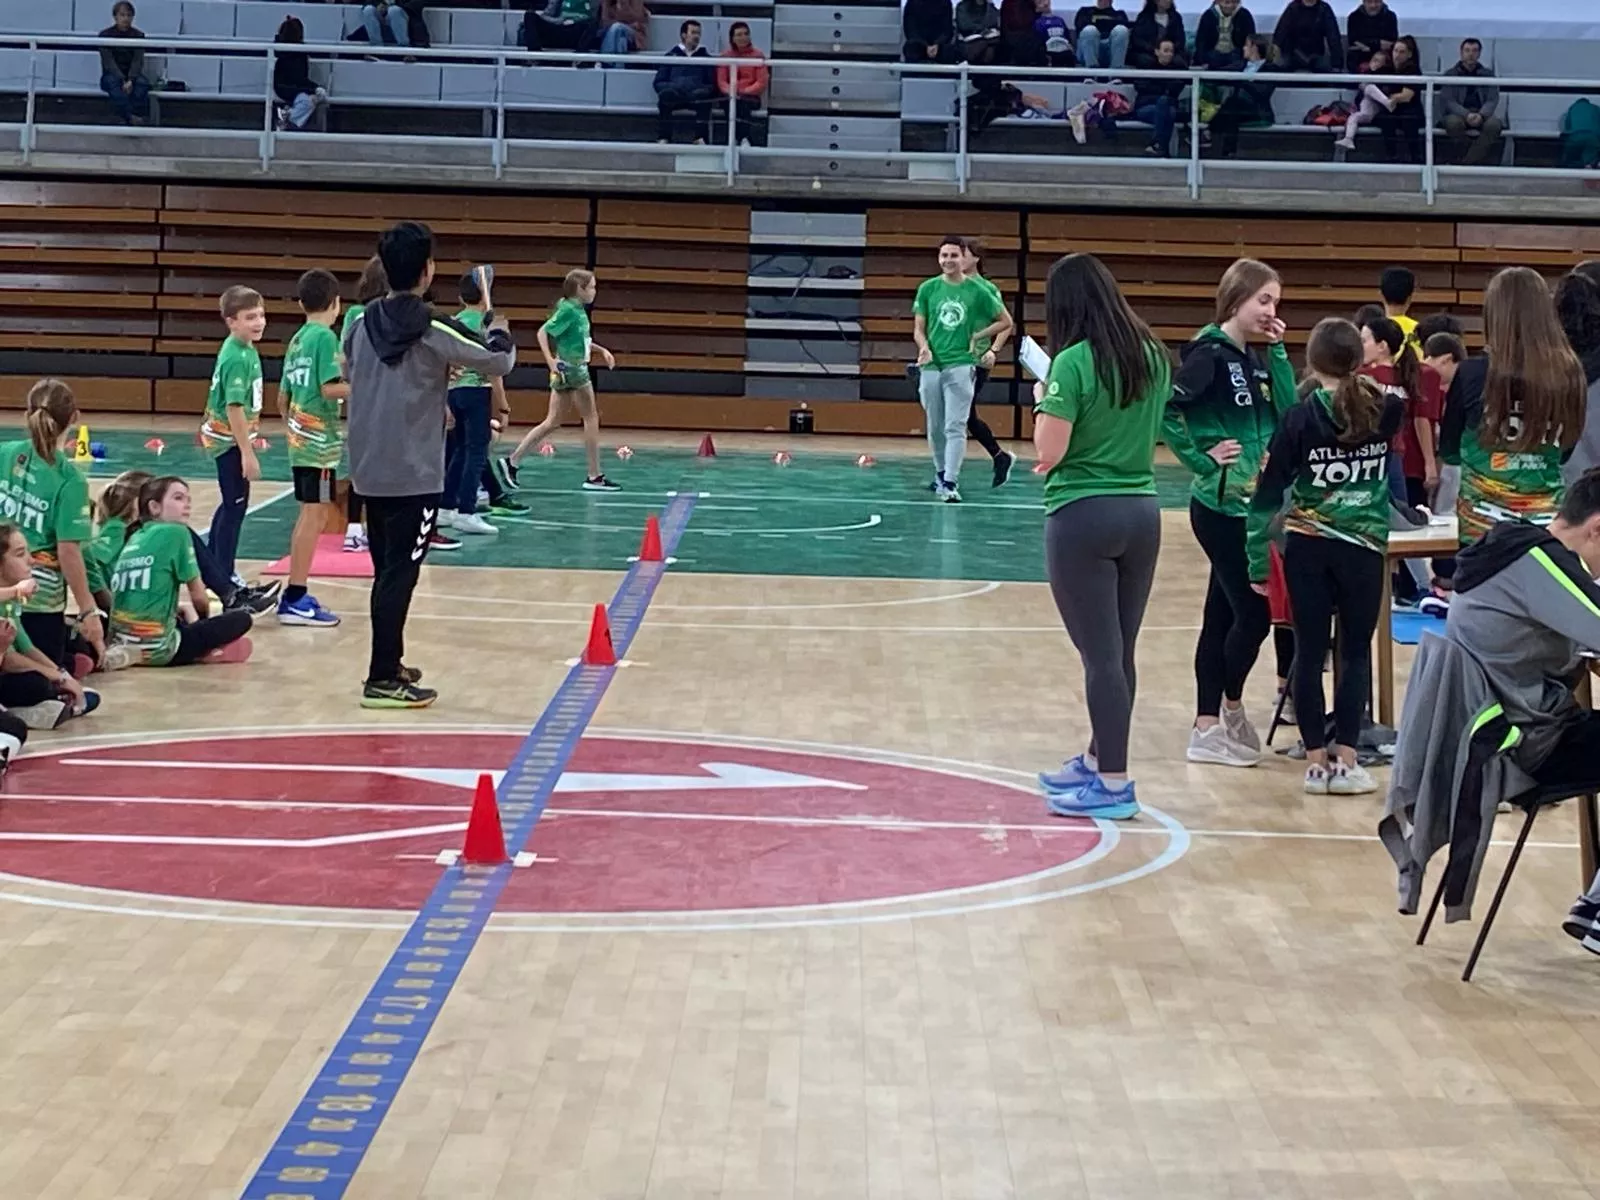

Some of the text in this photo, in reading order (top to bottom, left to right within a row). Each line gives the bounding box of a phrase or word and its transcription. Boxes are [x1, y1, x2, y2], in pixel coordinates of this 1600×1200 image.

[78, 440, 87, 456] 3
[1308, 442, 1388, 461] ATLEISMO
[1310, 456, 1386, 488] ZOITI
[111, 567, 151, 592] OITI
